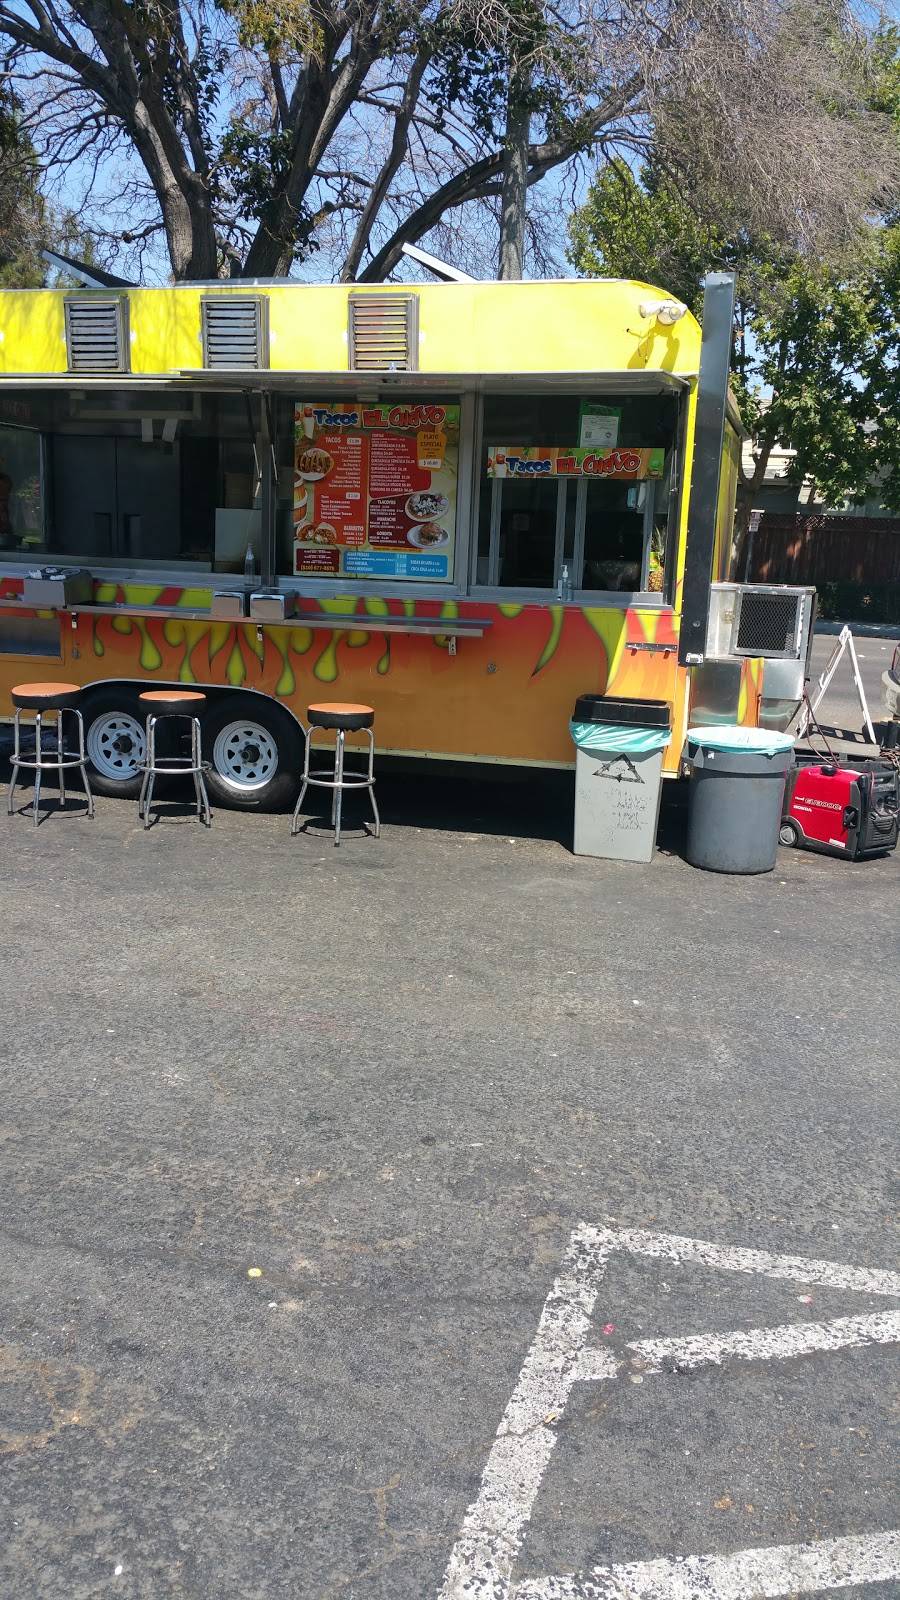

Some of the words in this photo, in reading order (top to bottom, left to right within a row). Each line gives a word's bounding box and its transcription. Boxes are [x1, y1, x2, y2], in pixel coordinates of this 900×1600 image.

[313, 409, 358, 426] Tacos
[362, 409, 388, 428] EL
[504, 457, 552, 474] Tacos
[555, 456, 582, 475] EL
